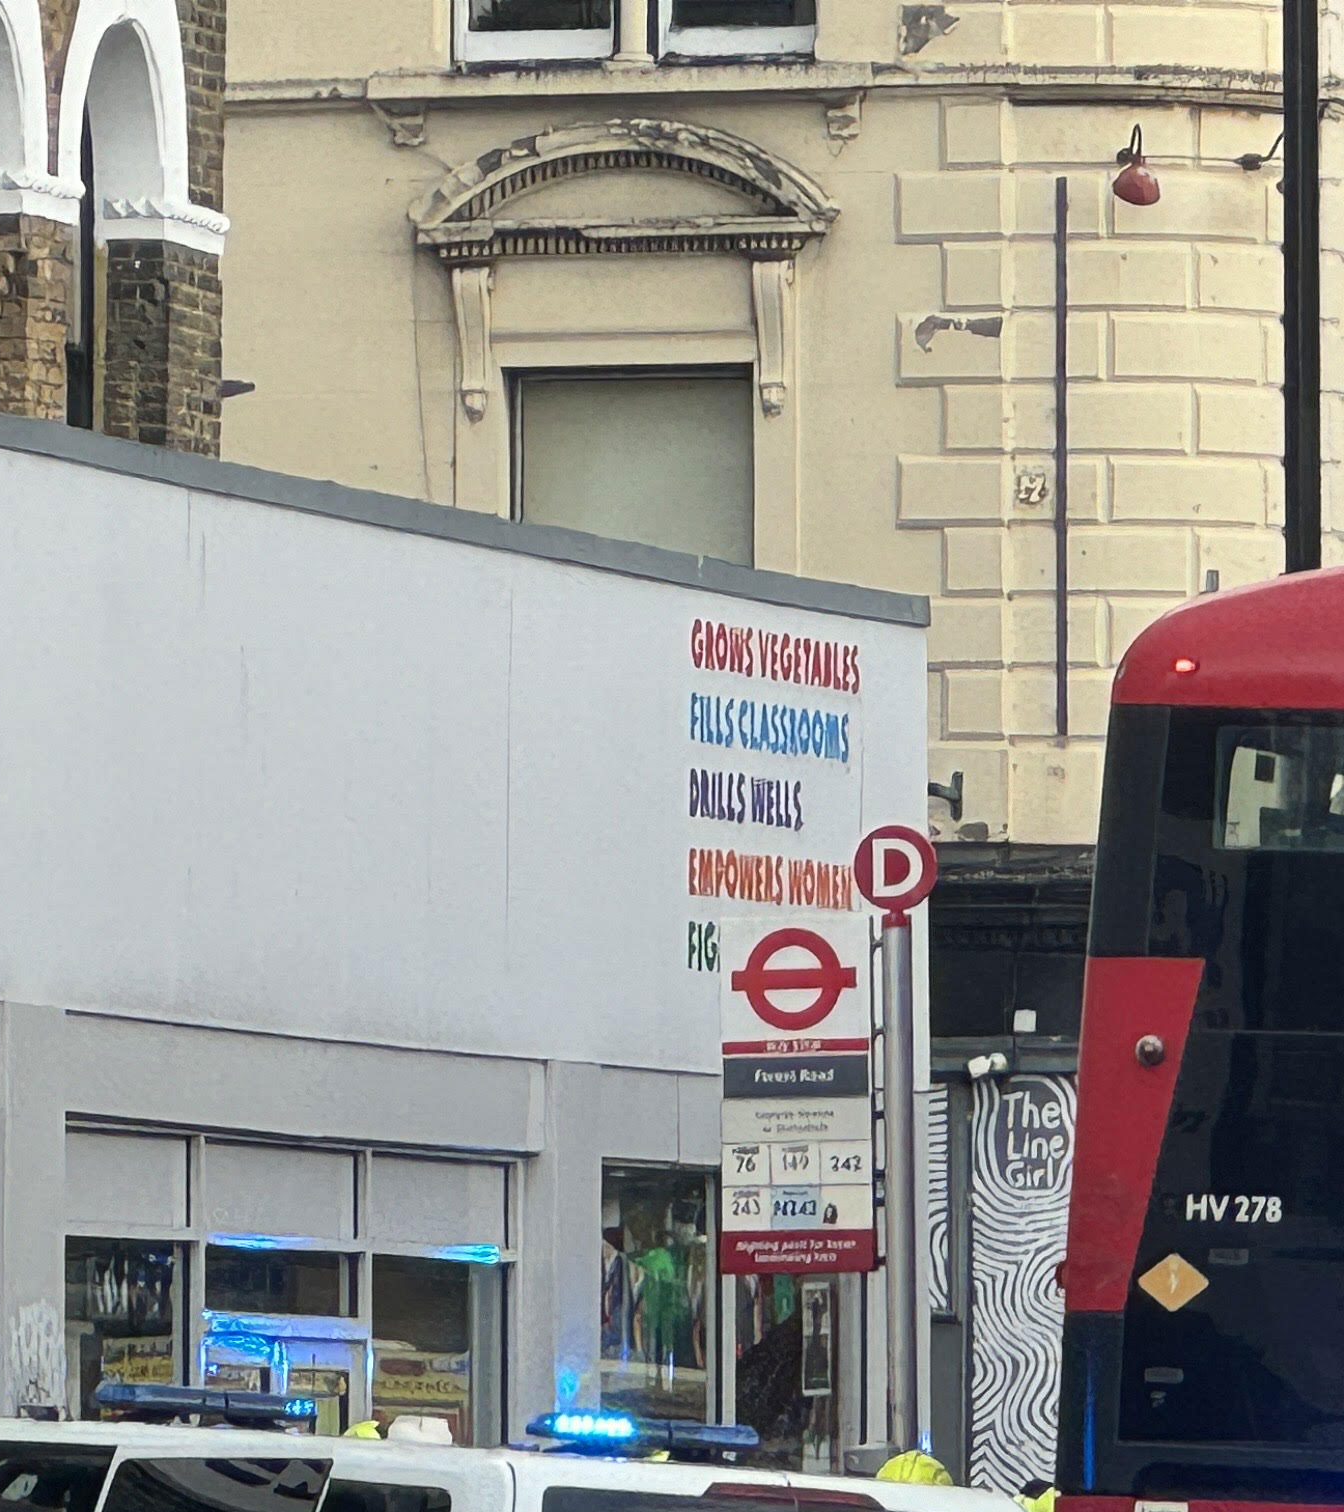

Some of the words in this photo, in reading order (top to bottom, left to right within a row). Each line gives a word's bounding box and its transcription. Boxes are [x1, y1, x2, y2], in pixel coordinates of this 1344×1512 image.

[691, 618, 754, 678] GROWS
[758, 628, 862, 695] VEGETABLES
[690, 691, 734, 748] FILLS
[738, 699, 850, 763] CLASSROOMS
[689, 768, 745, 823] DRILLS
[751, 776, 804, 831] WELLS
[688, 848, 784, 906] EMPOWERS
[788, 858, 854, 911] WOMEN
[872, 837, 923, 898] D
[688, 920, 720, 974] FIG
[1003, 1089, 1061, 1129] The
[1004, 1159, 1055, 1189] Girl
[1006, 1128, 1065, 1163] Line
[1185, 1195, 1230, 1224] HV
[1235, 1196, 1283, 1225] 278
